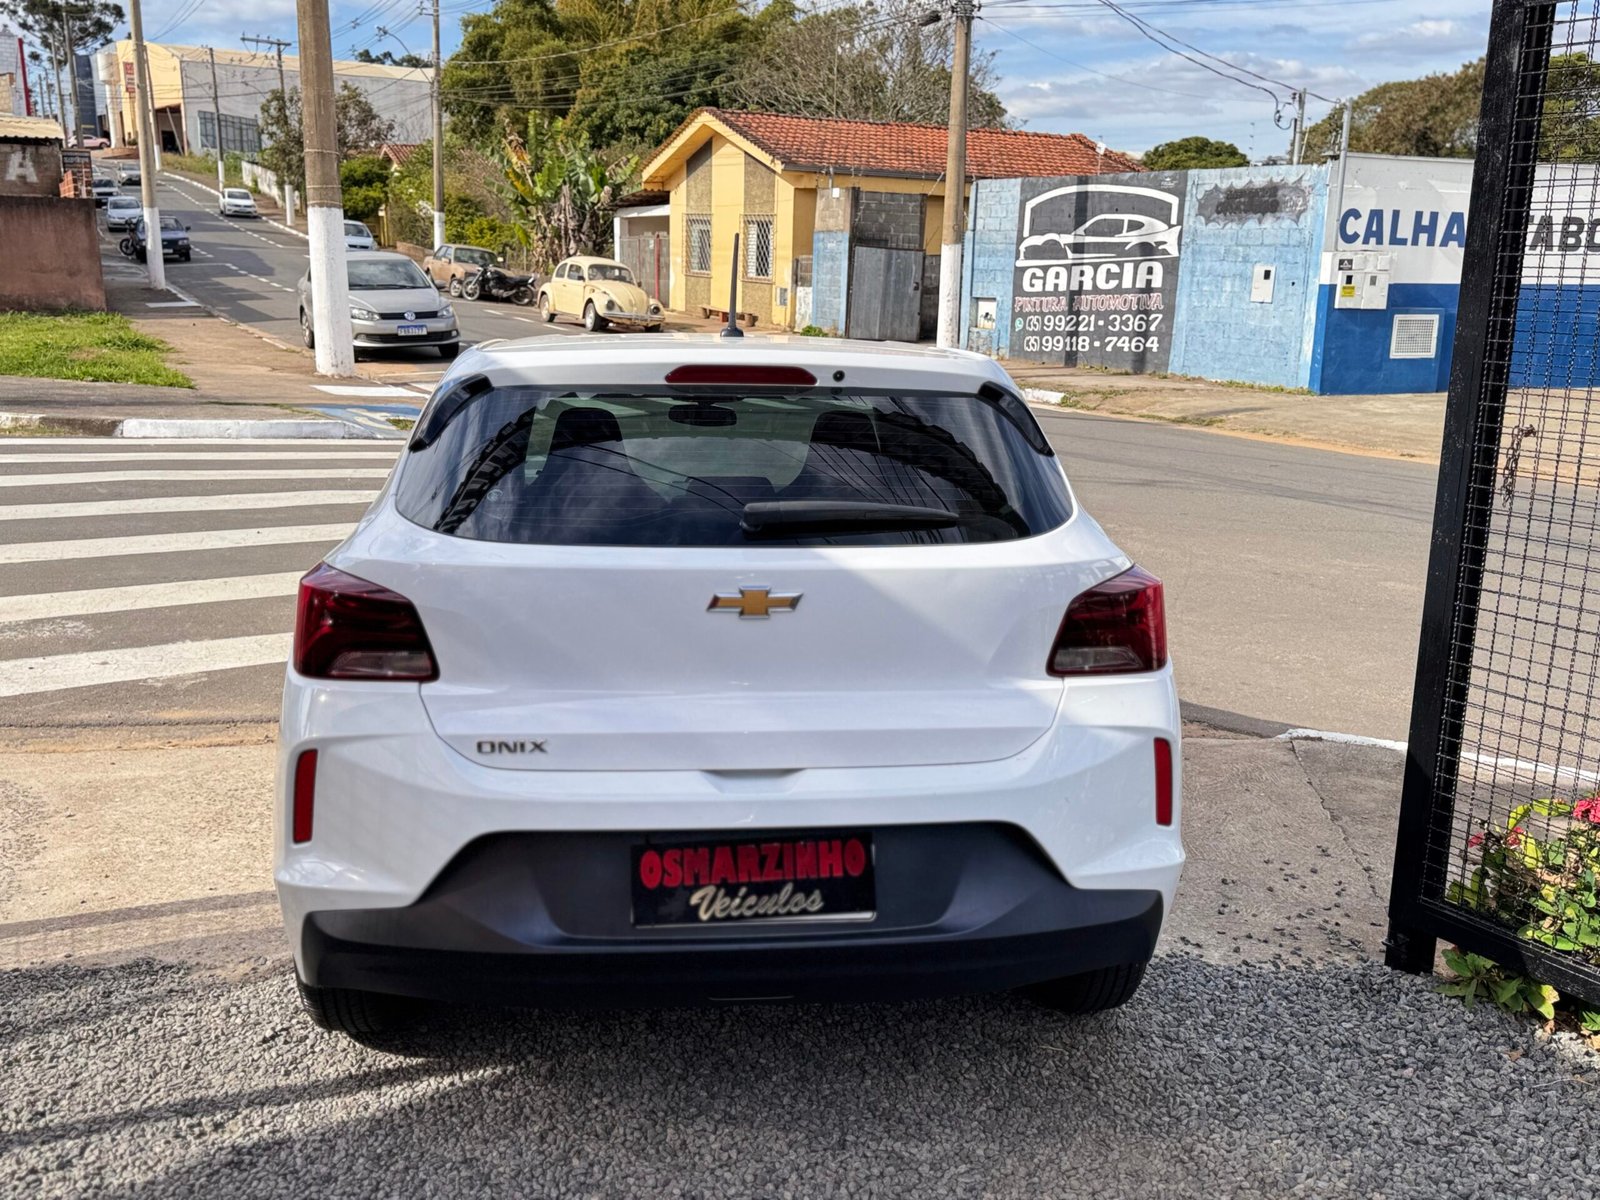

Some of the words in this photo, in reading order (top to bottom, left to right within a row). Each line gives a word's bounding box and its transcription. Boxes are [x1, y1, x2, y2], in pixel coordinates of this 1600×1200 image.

[5, 149, 39, 183] A
[1339, 208, 1466, 248] CALHA
[1022, 261, 1164, 292] GARCIA
[1014, 295, 1068, 312] PINTURA
[1072, 293, 1164, 311] AUTOMOTIVA
[477, 741, 548, 754] ONIX
[640, 839, 866, 889] OSMARZINHO
[690, 882, 824, 921] Veículos
